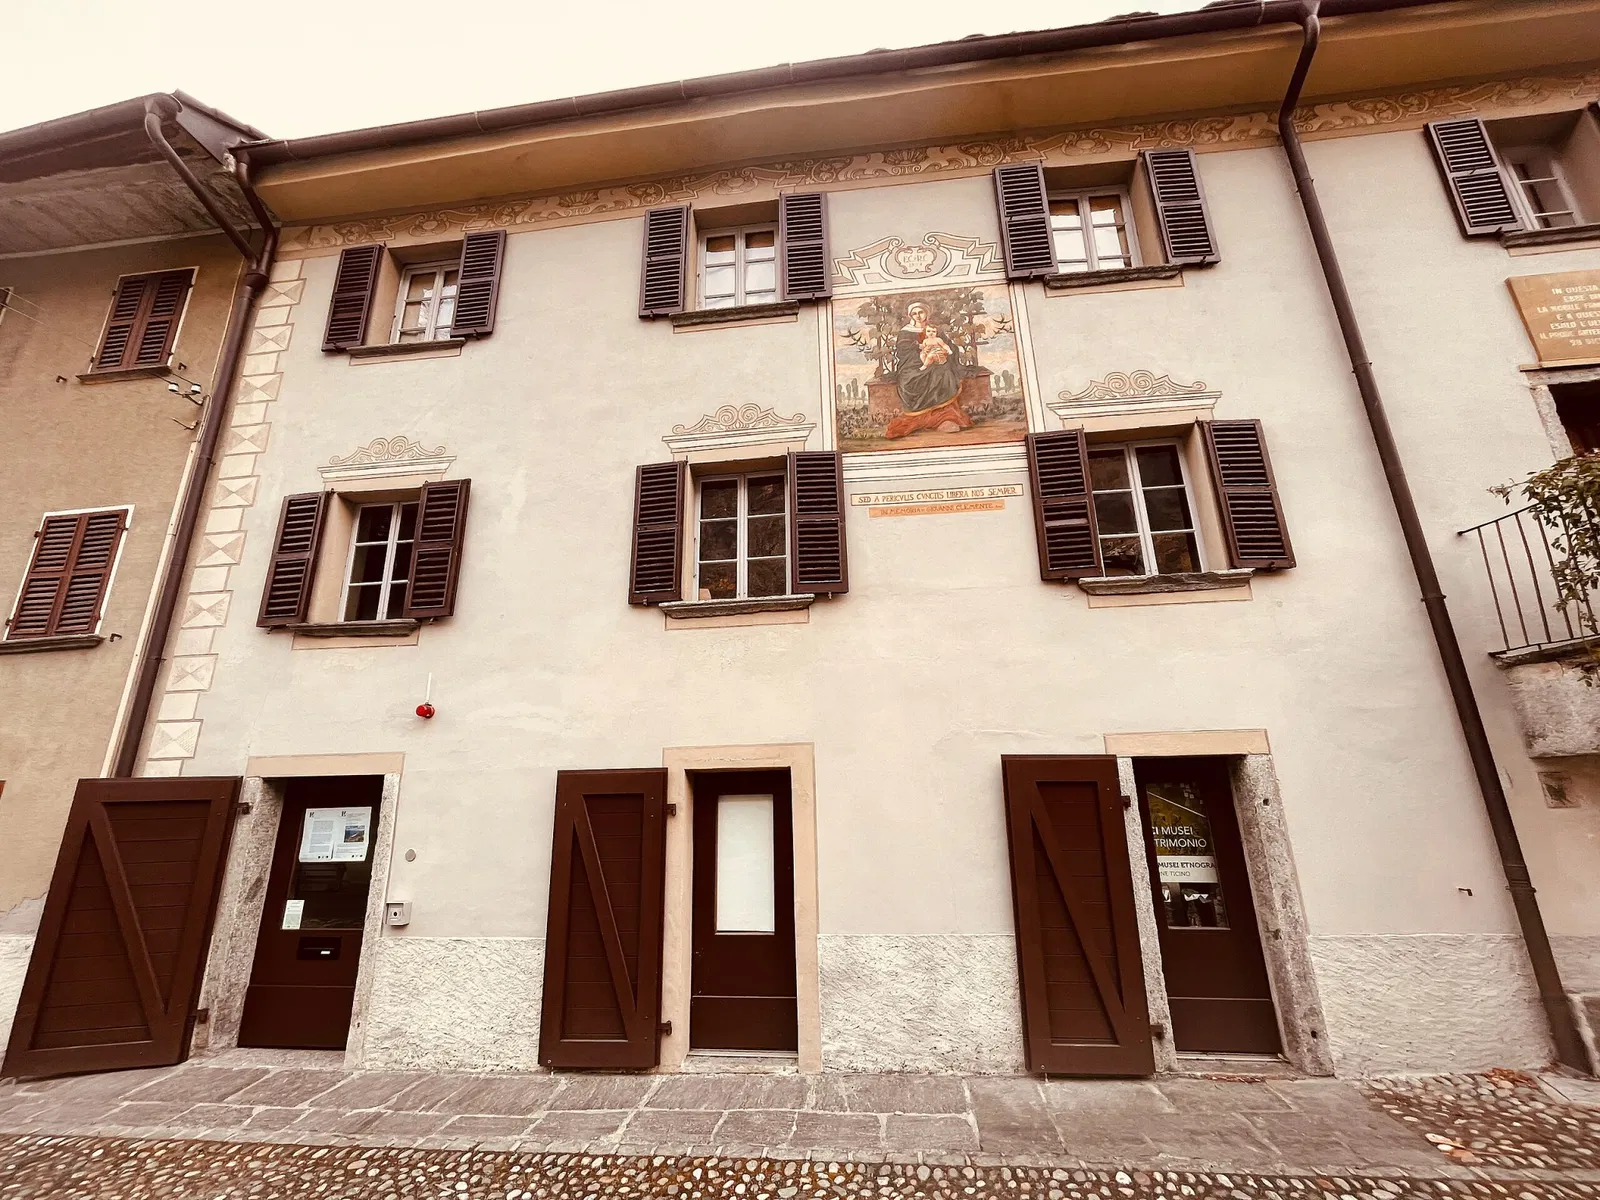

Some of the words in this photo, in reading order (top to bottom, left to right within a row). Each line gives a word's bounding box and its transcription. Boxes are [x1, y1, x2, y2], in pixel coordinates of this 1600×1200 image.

[1551, 287, 1563, 295] IN
[1565, 285, 1599, 293] QUESTA
[858, 496, 872, 504] SED
[946, 490, 969, 499] LIBERA
[971, 488, 985, 497] NOS
[988, 486, 1017, 496] SEMPER
[955, 503, 994, 511] CLEMENTE
[1161, 826, 1194, 835] MUSEI
